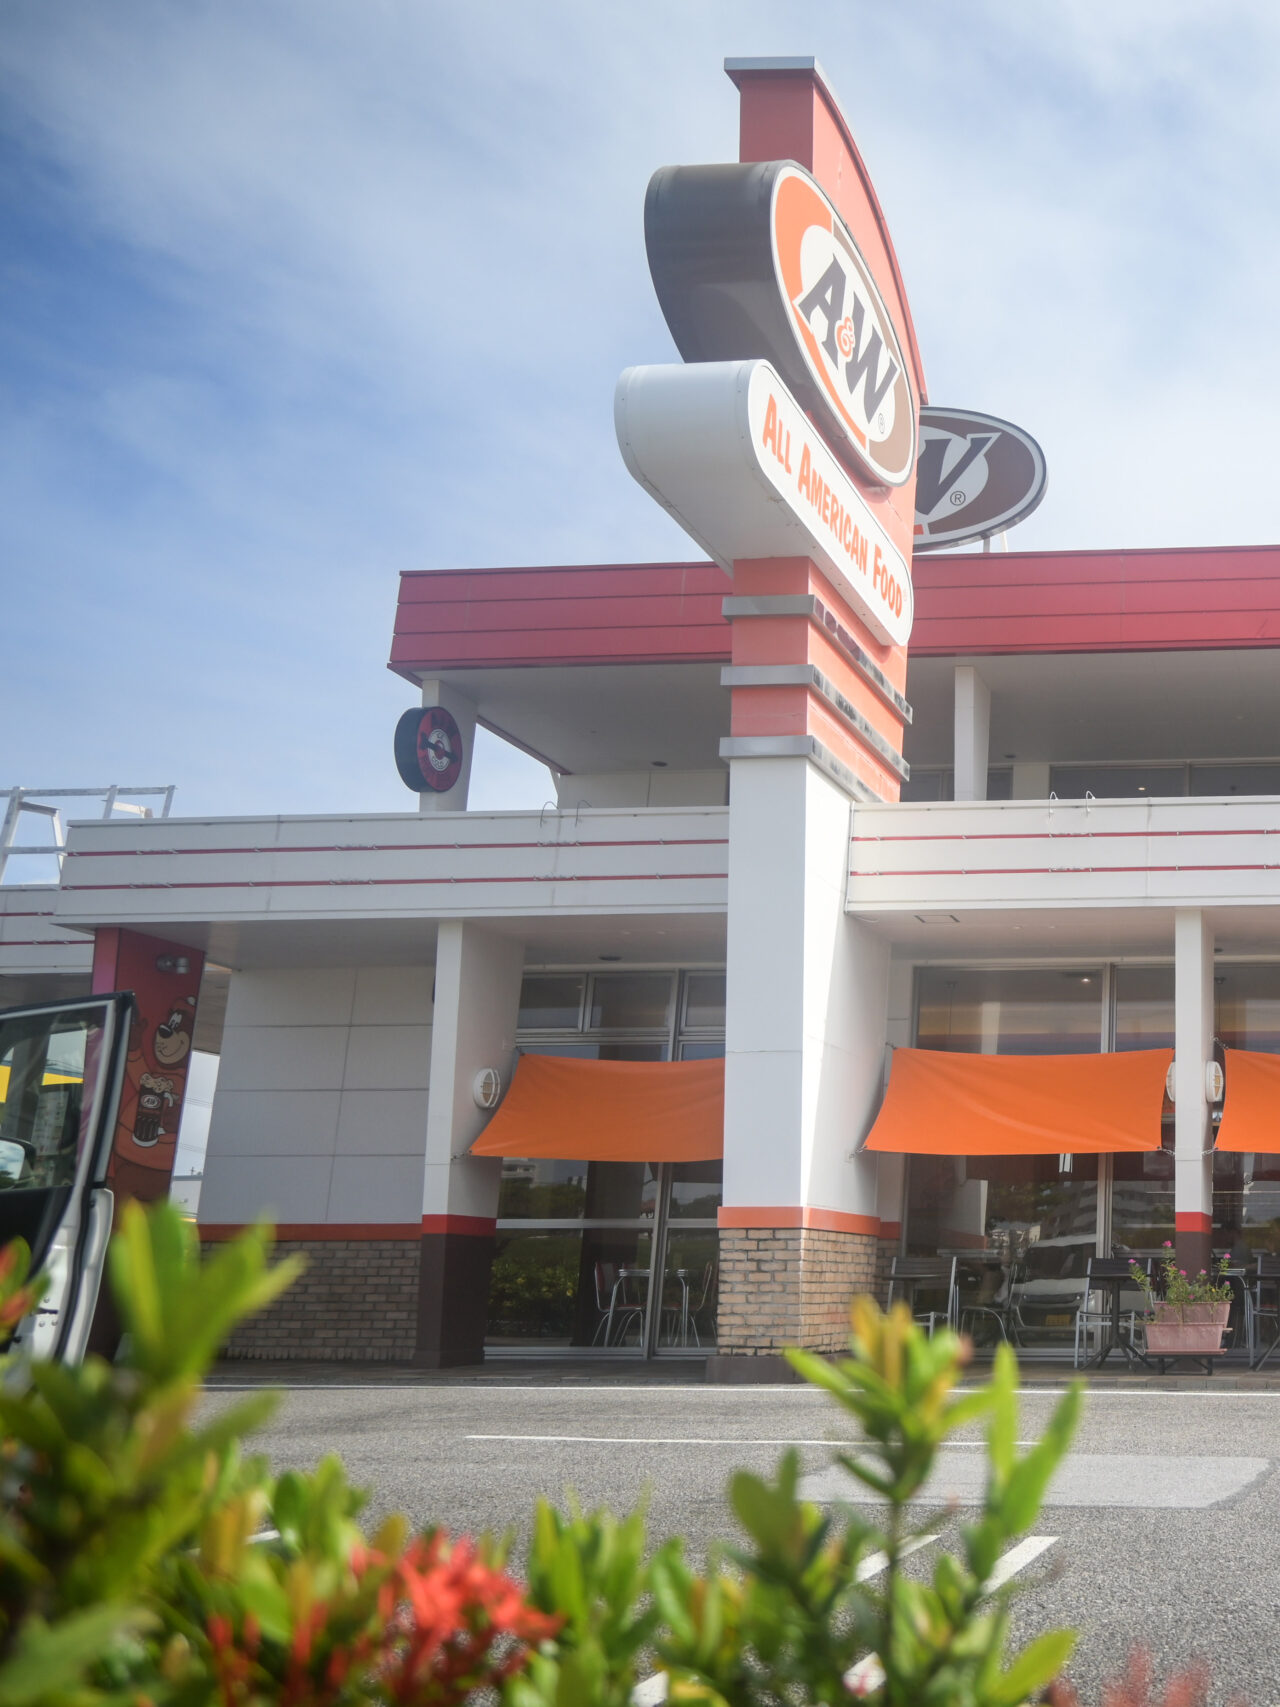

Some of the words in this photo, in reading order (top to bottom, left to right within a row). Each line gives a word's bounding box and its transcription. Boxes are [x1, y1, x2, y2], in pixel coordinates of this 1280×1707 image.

[798, 253, 899, 424] A&W
[762, 393, 792, 475] ALL
[797, 442, 869, 576] AMERICAN
[873, 543, 903, 619] FOOD
